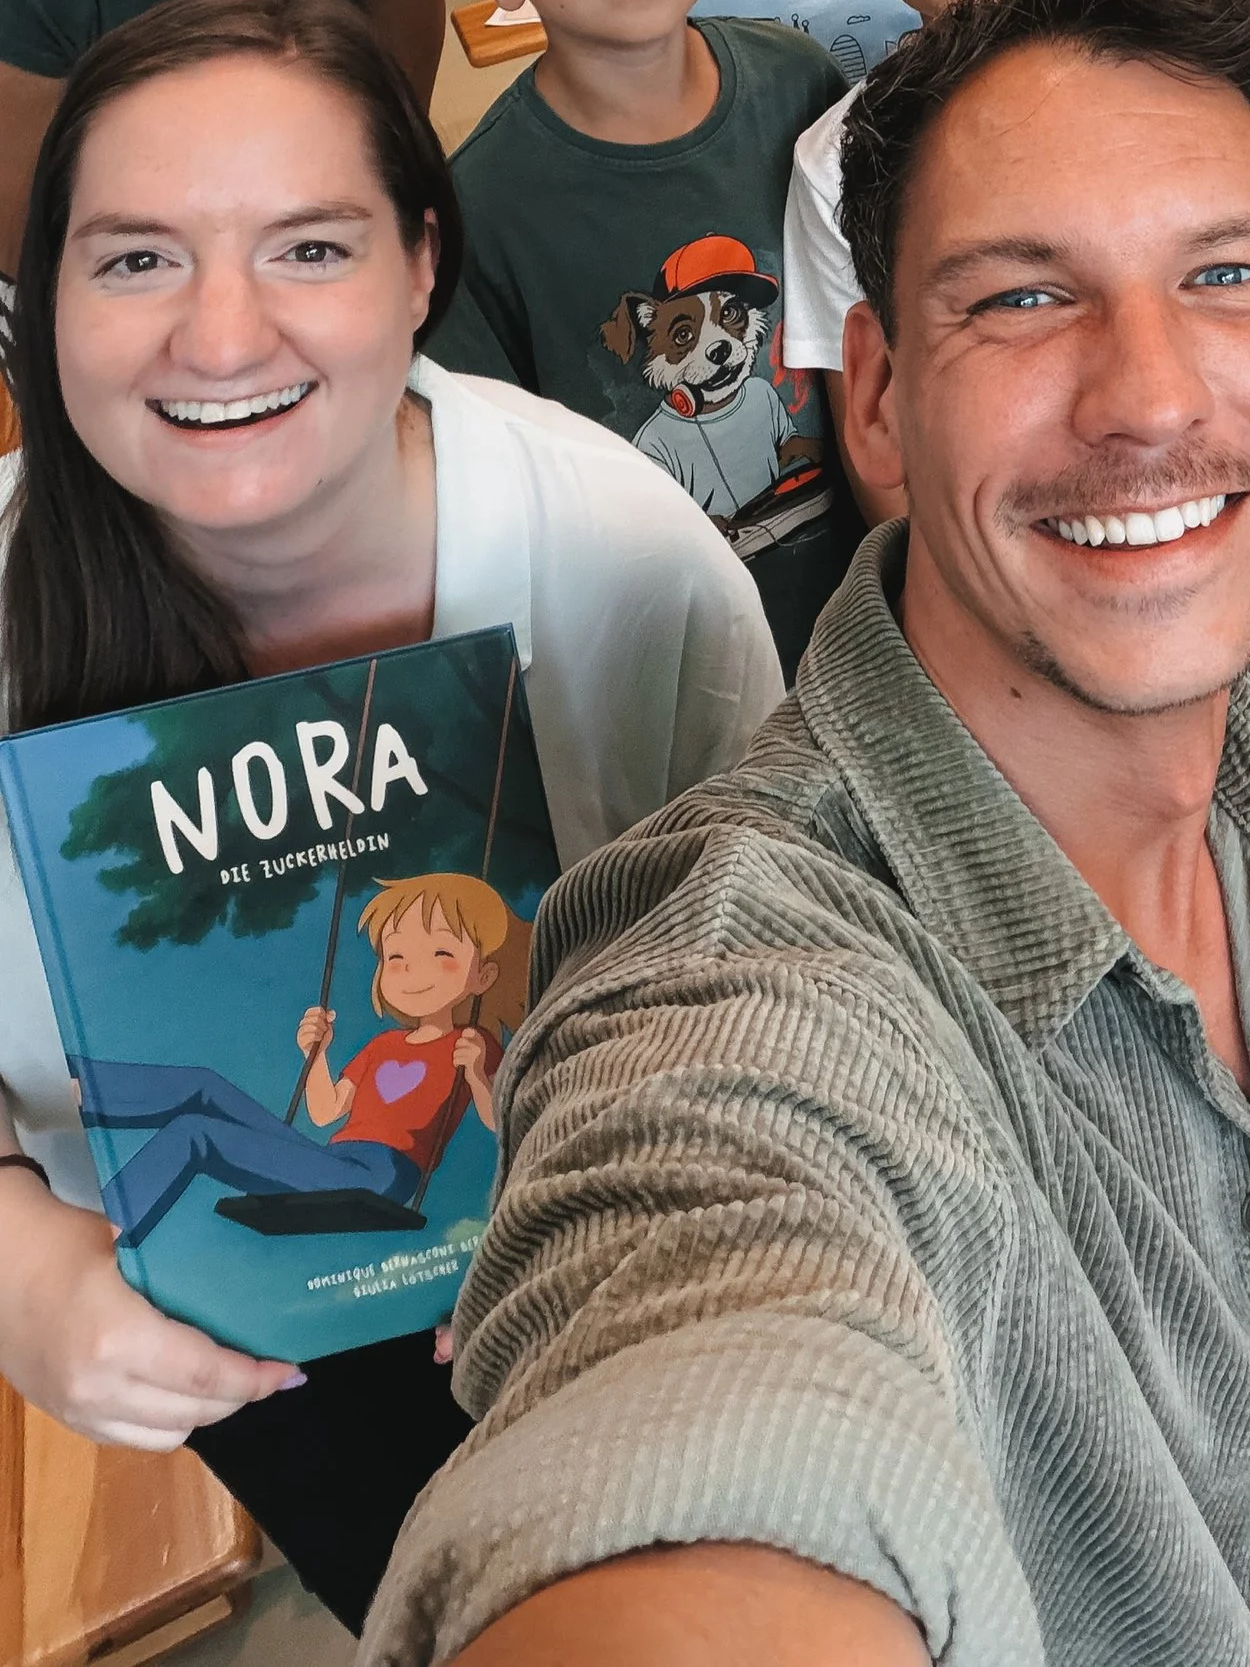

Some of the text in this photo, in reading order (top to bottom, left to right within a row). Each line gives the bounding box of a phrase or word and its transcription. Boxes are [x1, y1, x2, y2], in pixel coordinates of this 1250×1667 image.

[149, 720, 429, 876] NORA
[220, 832, 391, 885] DIE ZUCKERHELDIN
